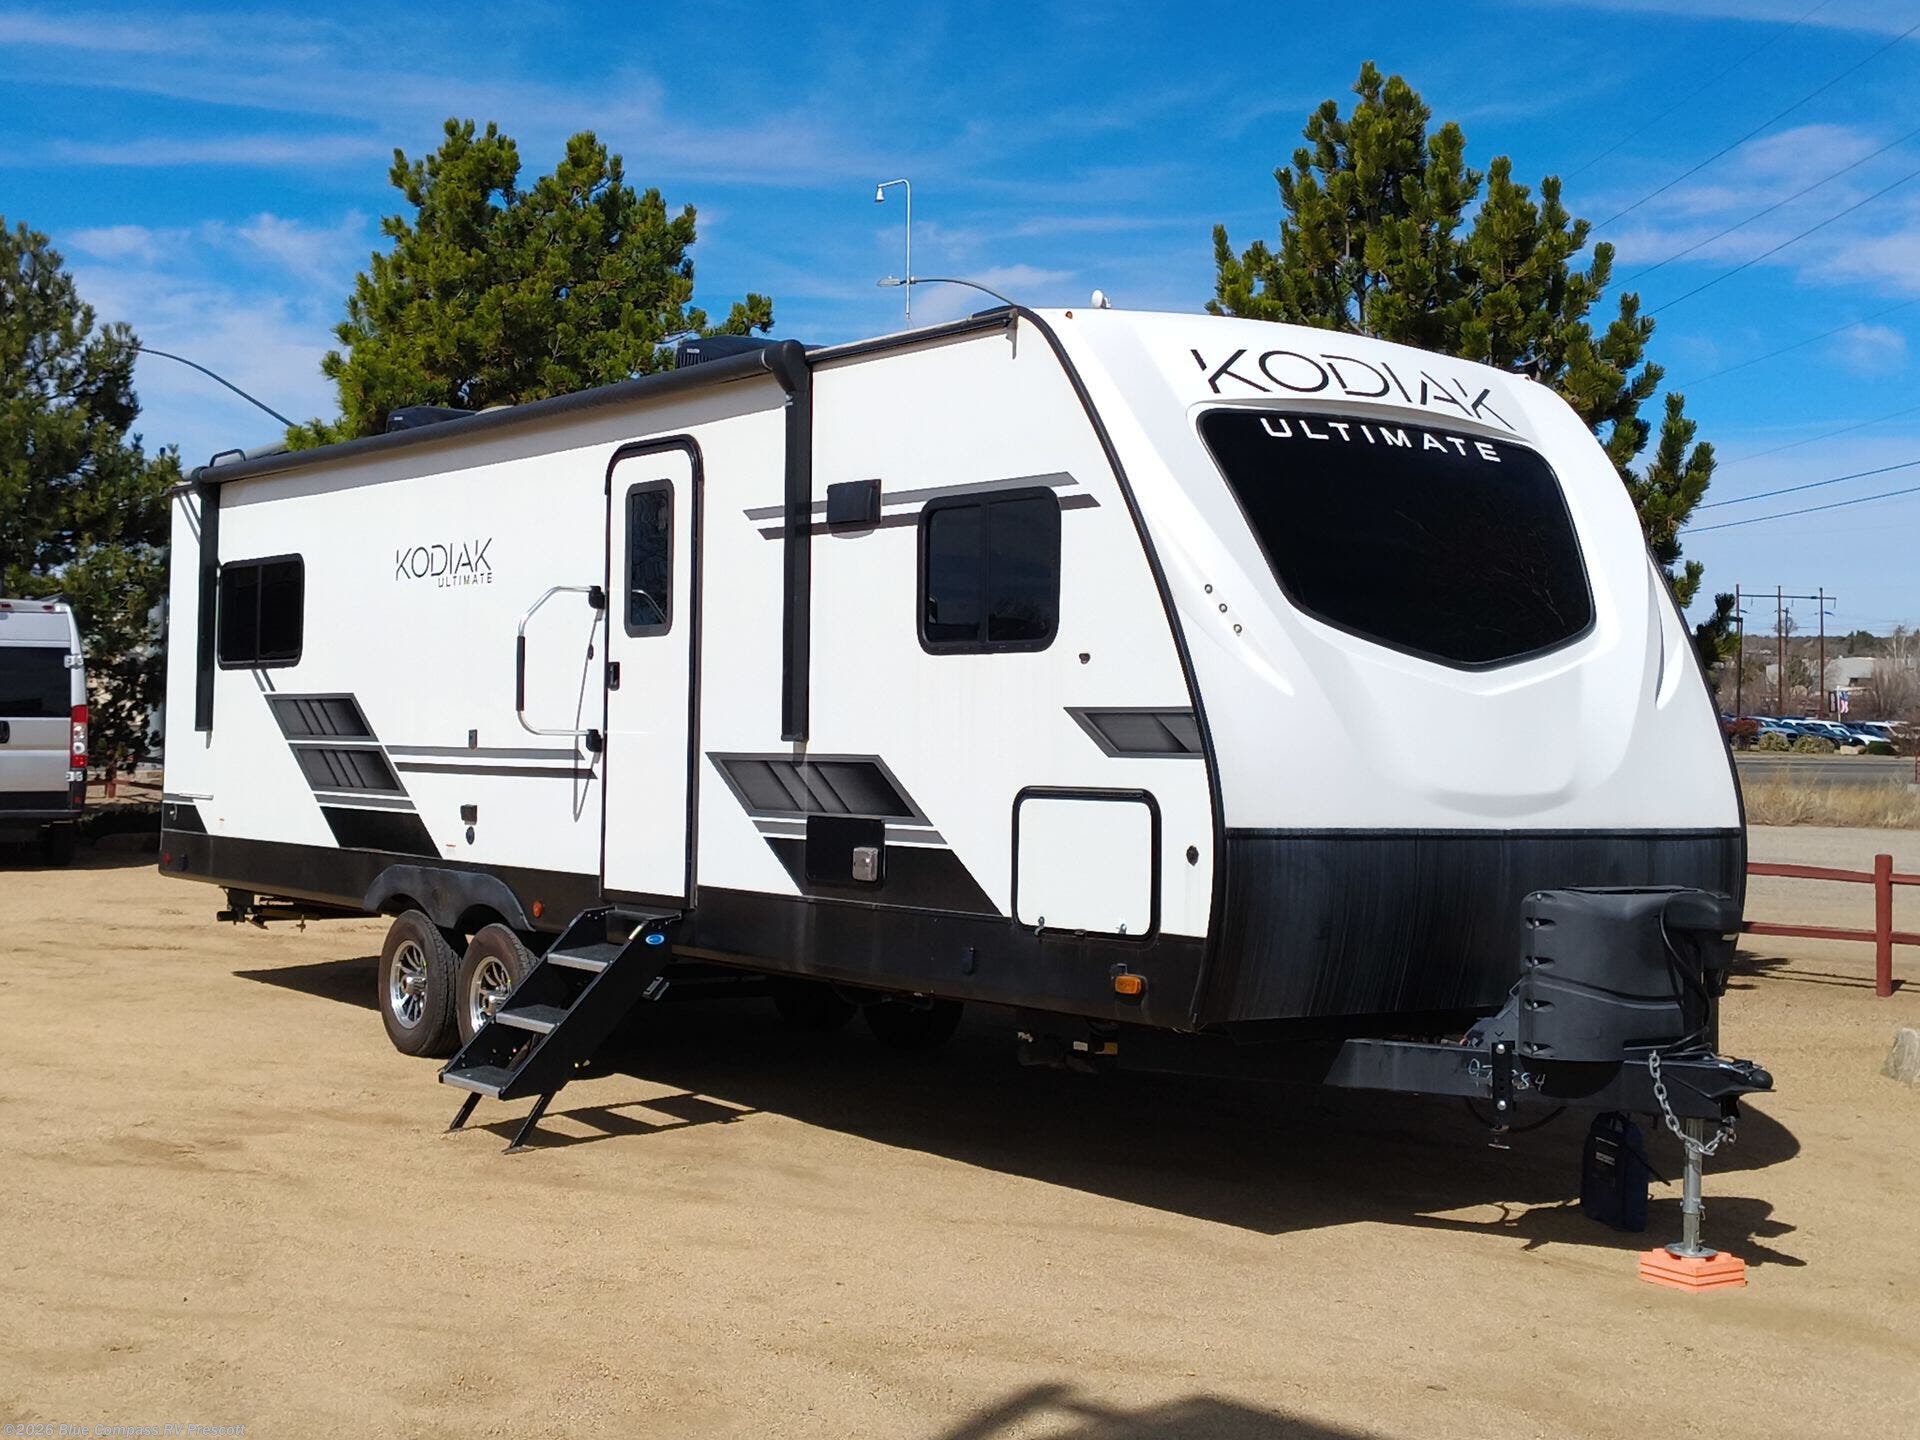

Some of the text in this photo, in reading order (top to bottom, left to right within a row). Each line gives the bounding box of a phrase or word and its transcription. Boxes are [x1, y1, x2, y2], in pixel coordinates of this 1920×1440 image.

[1189, 348, 1518, 432] KODIAK
[1259, 416, 1502, 463] ULTIMATE
[395, 537, 492, 582] KODIAK
[437, 572, 493, 588] ULTIMATE
